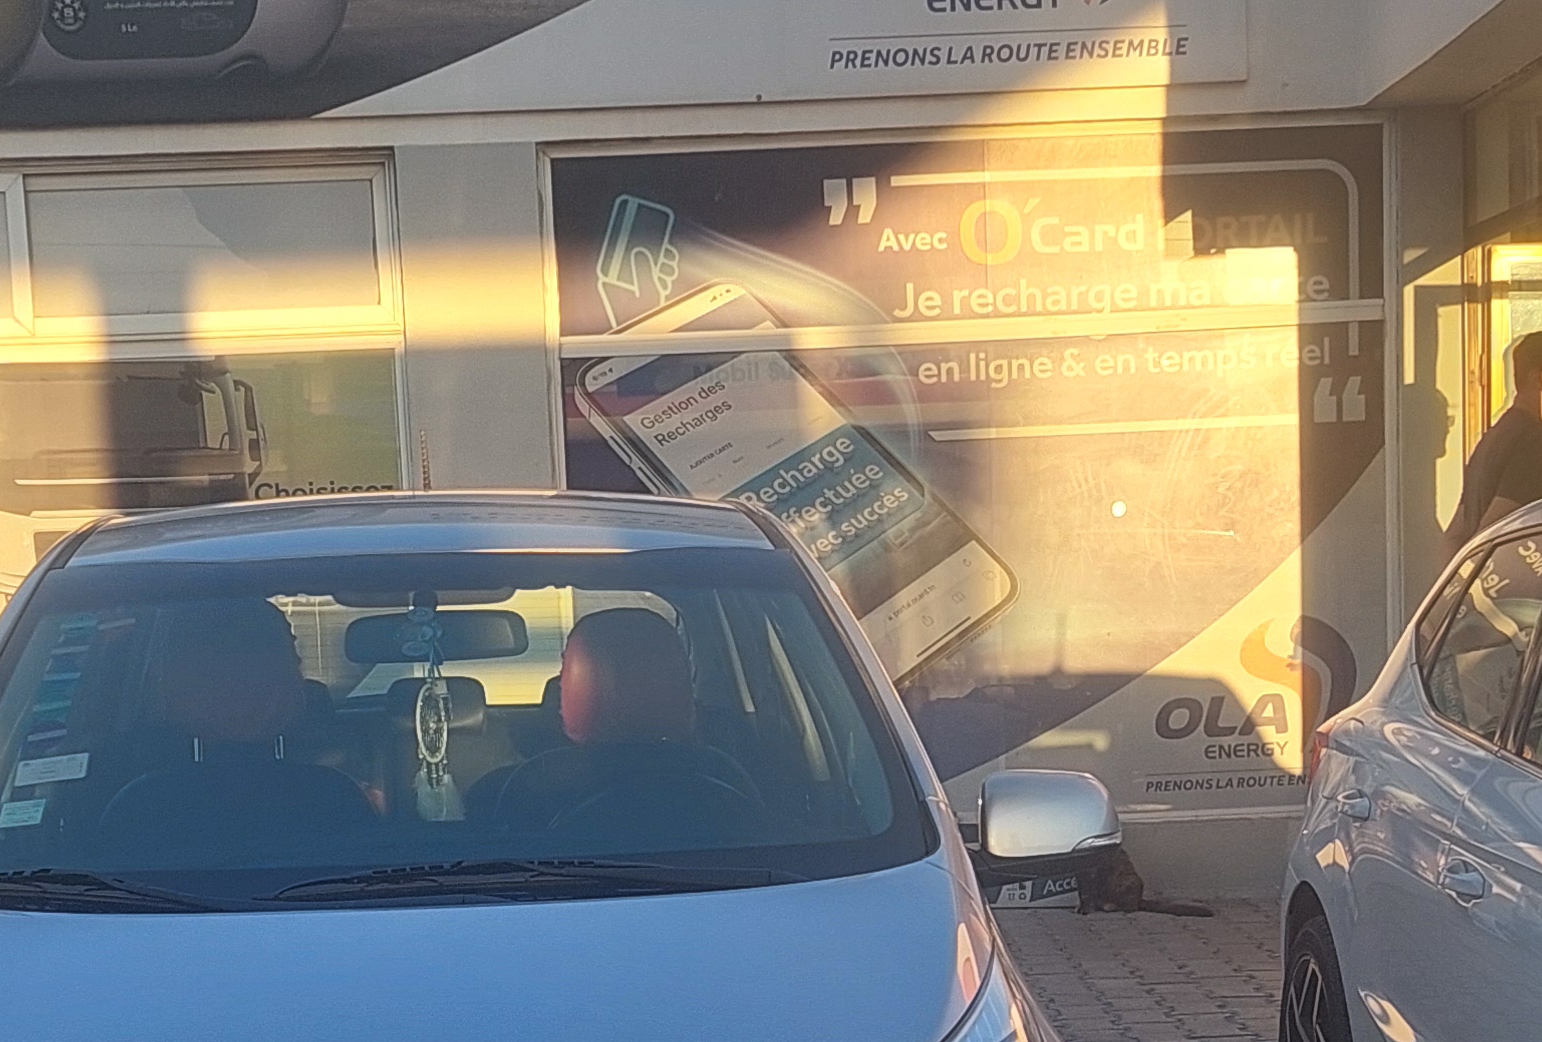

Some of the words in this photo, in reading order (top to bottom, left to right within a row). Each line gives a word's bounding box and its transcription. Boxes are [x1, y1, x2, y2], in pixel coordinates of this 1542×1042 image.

[829, 46, 942, 71] PRENONS
[946, 44, 976, 66] LA
[980, 41, 1061, 64] ROUTE
[1064, 36, 1190, 61] ENSEMBLE
[878, 227, 948, 252] Avec
[1157, 211, 1329, 262] ORTAIL
[893, 282, 941, 318] Je
[952, 278, 1138, 323] recharge
[1149, 280, 1212, 308] ma
[1222, 274, 1330, 306] cte
[918, 361, 960, 385] en
[969, 352, 1053, 389] ligne
[1061, 348, 1086, 377] &
[1093, 350, 1136, 375] en
[1144, 341, 1257, 382] temps
[639, 393, 700, 431] Gestion
[697, 379, 726, 401] des
[652, 399, 733, 448] Recharges
[739, 435, 854, 513] Recharge
[779, 460, 884, 534] ffectuée
[808, 528, 842, 560] vec
[836, 484, 909, 538] succès
[1155, 693, 1289, 740] OLA
[1204, 741, 1289, 760] ENERGY
[1146, 778, 1214, 793] PRENONS
[1216, 777, 1233, 790] LA
[1237, 774, 1284, 789] ROUTE
[1287, 773, 1307, 786] EN
[1042, 877, 1078, 896] Acce
